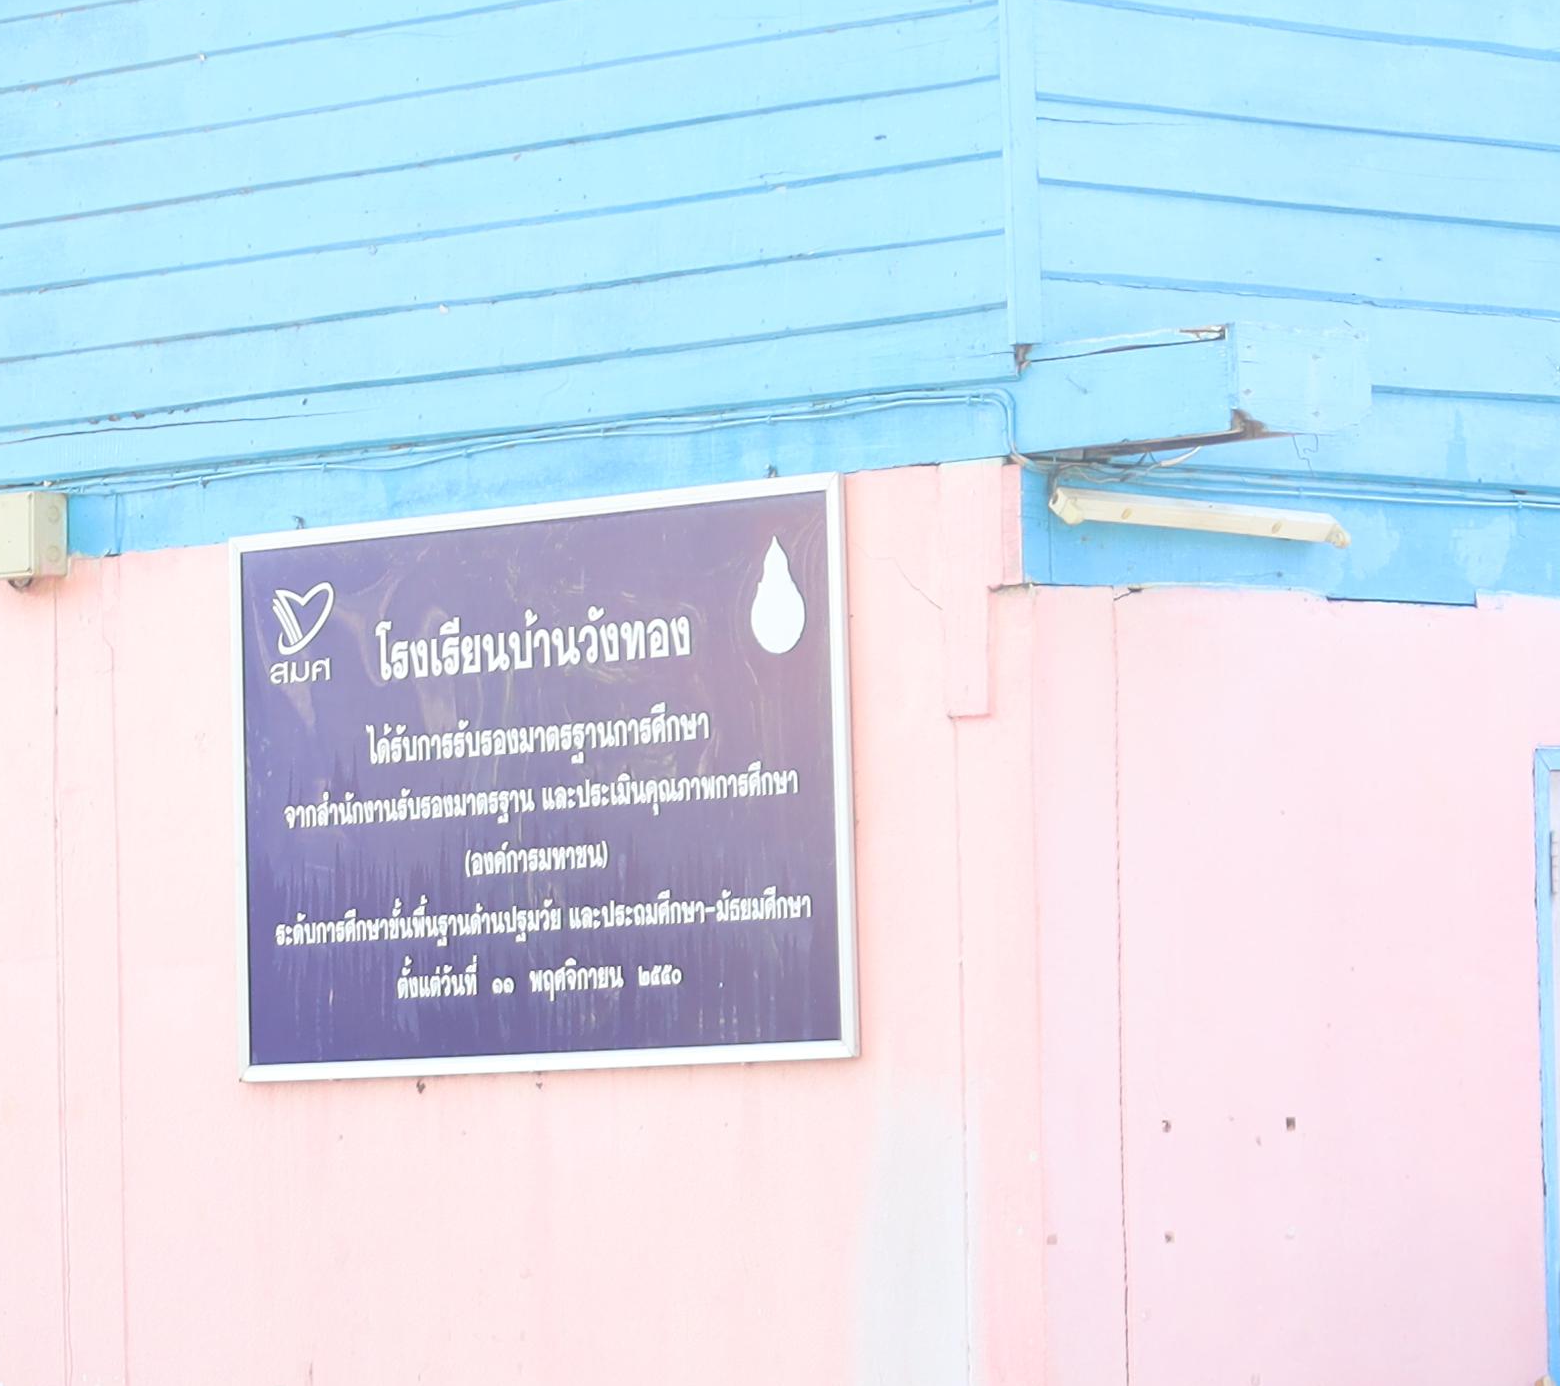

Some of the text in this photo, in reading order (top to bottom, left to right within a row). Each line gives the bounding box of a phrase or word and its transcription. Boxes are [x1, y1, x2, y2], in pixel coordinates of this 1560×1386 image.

[269, 656, 332, 685] สมศ
[374, 604, 692, 682] โรงเรียนบ้านวังทอง
[365, 701, 710, 765] ได้รับการรับรองมาตรฐานการศึกษา
[283, 760, 800, 829] จากสำนักงานรับรองมาตรฐาน และประเมินคุณภาพการศึกษา
[464, 840, 609, 878] (องค์การมหาชน)
[274, 885, 812, 947] ระดับการศึกษาขั้นพื้นฐานด้านปฐมวัย และประถมศึกษา-มัธยมศึกษา
[396, 954, 683, 1003] ตั้งแต่วันที่ ๑๑ พฤศจิกายน ๒๕๕๐
